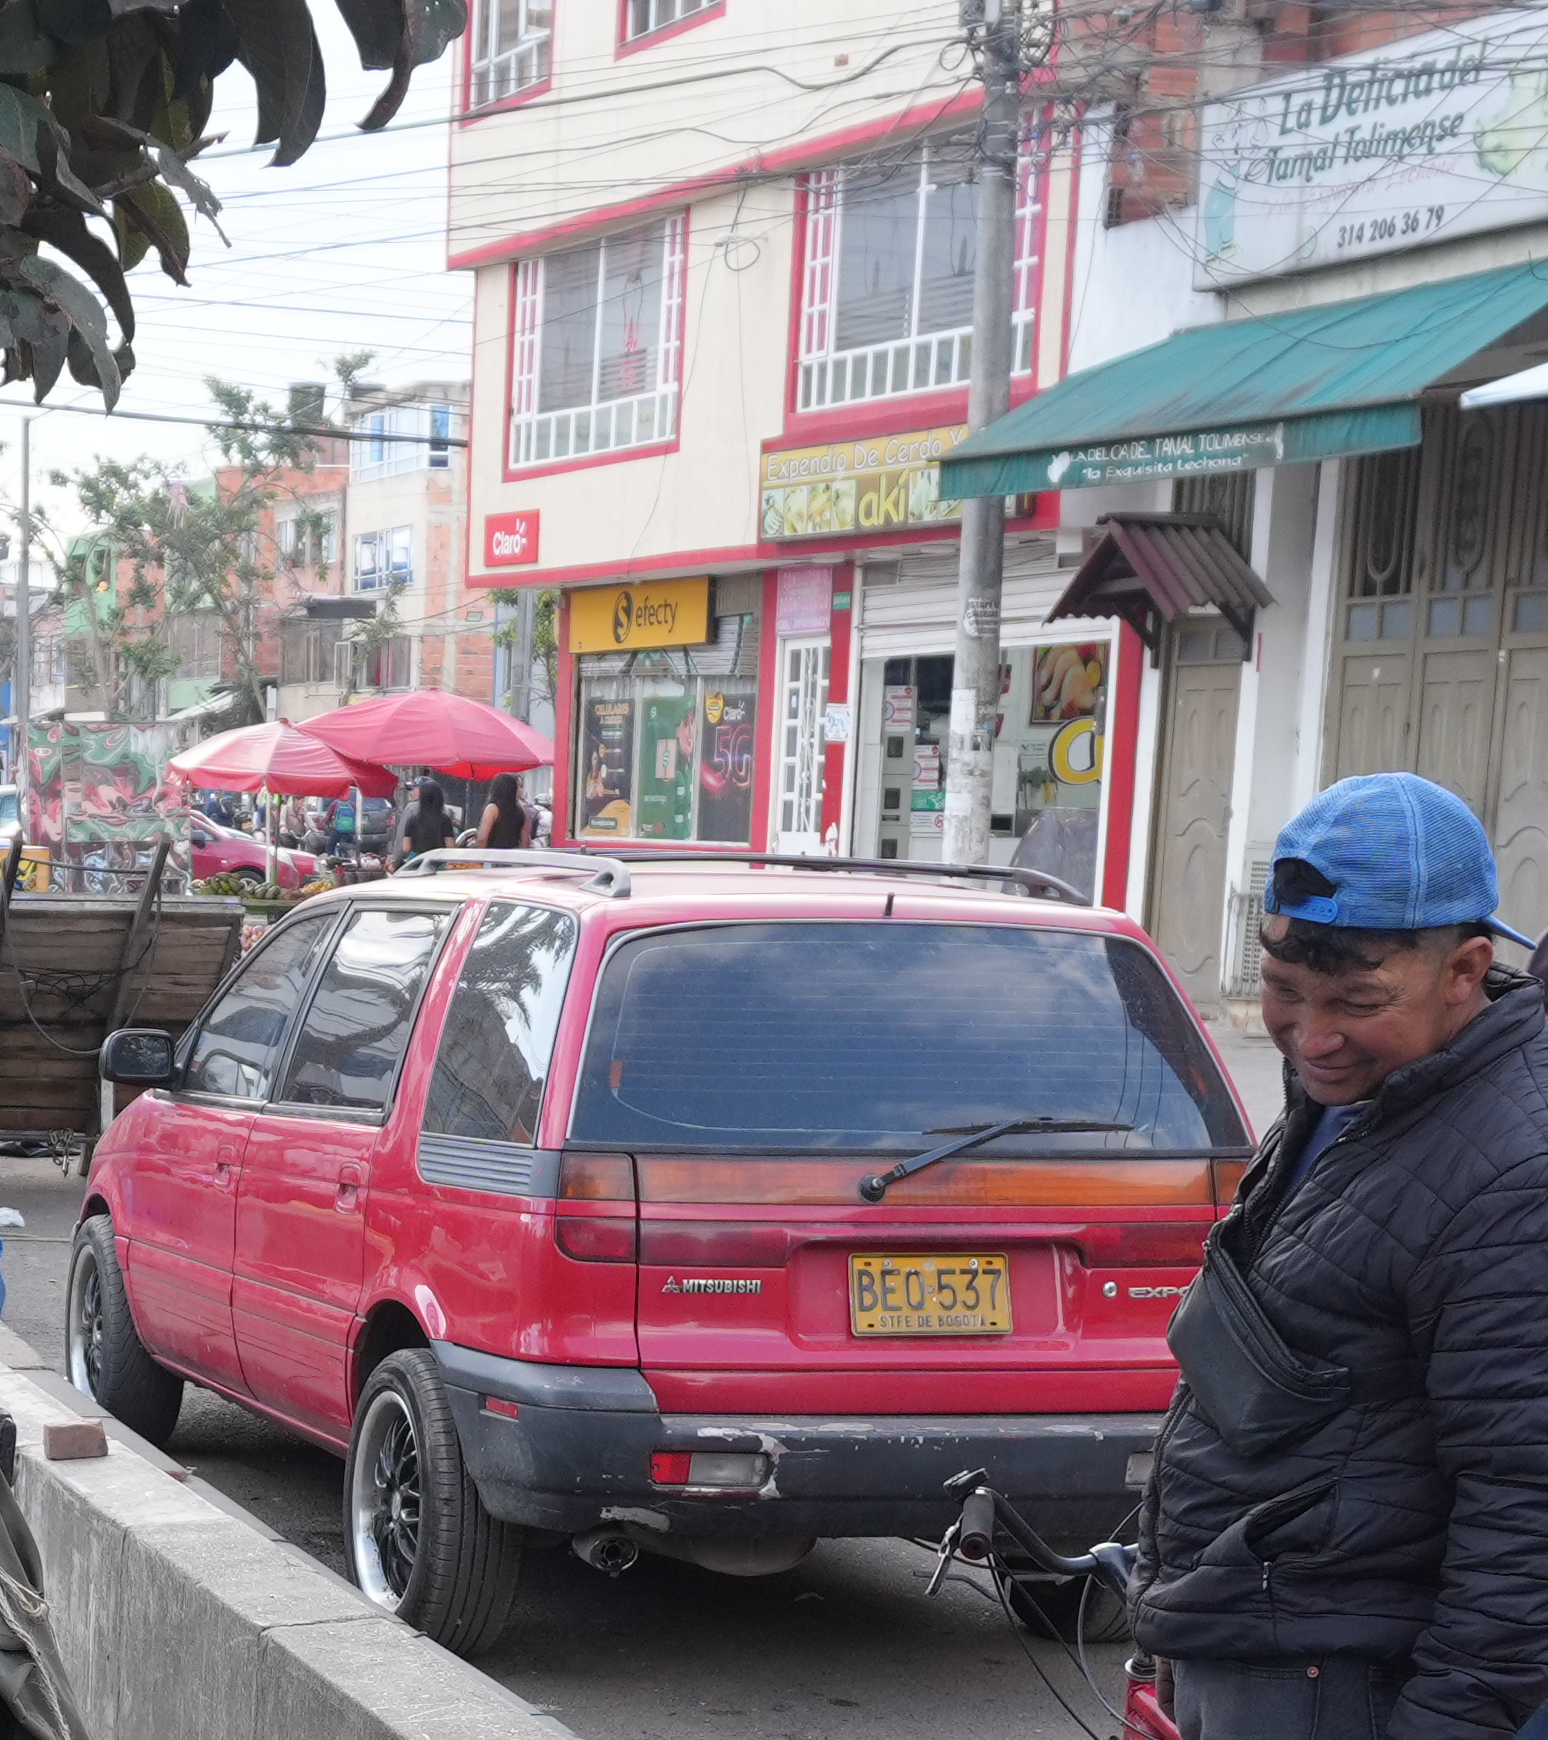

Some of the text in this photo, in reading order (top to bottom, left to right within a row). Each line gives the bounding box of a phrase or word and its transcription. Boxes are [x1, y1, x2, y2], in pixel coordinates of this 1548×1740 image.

[1278, 92, 1312, 136] La
[1337, 205, 1445, 248] 314 206 36 79
[767, 452, 847, 482] Expendio
[855, 443, 878, 467] De
[884, 438, 943, 463] Cerdo
[1106, 462, 1173, 478] Exquisita
[635, 598, 678, 634] efecty
[682, 1279, 762, 1294] MITSUBISHI
[917, 1315, 933, 1328] DE
